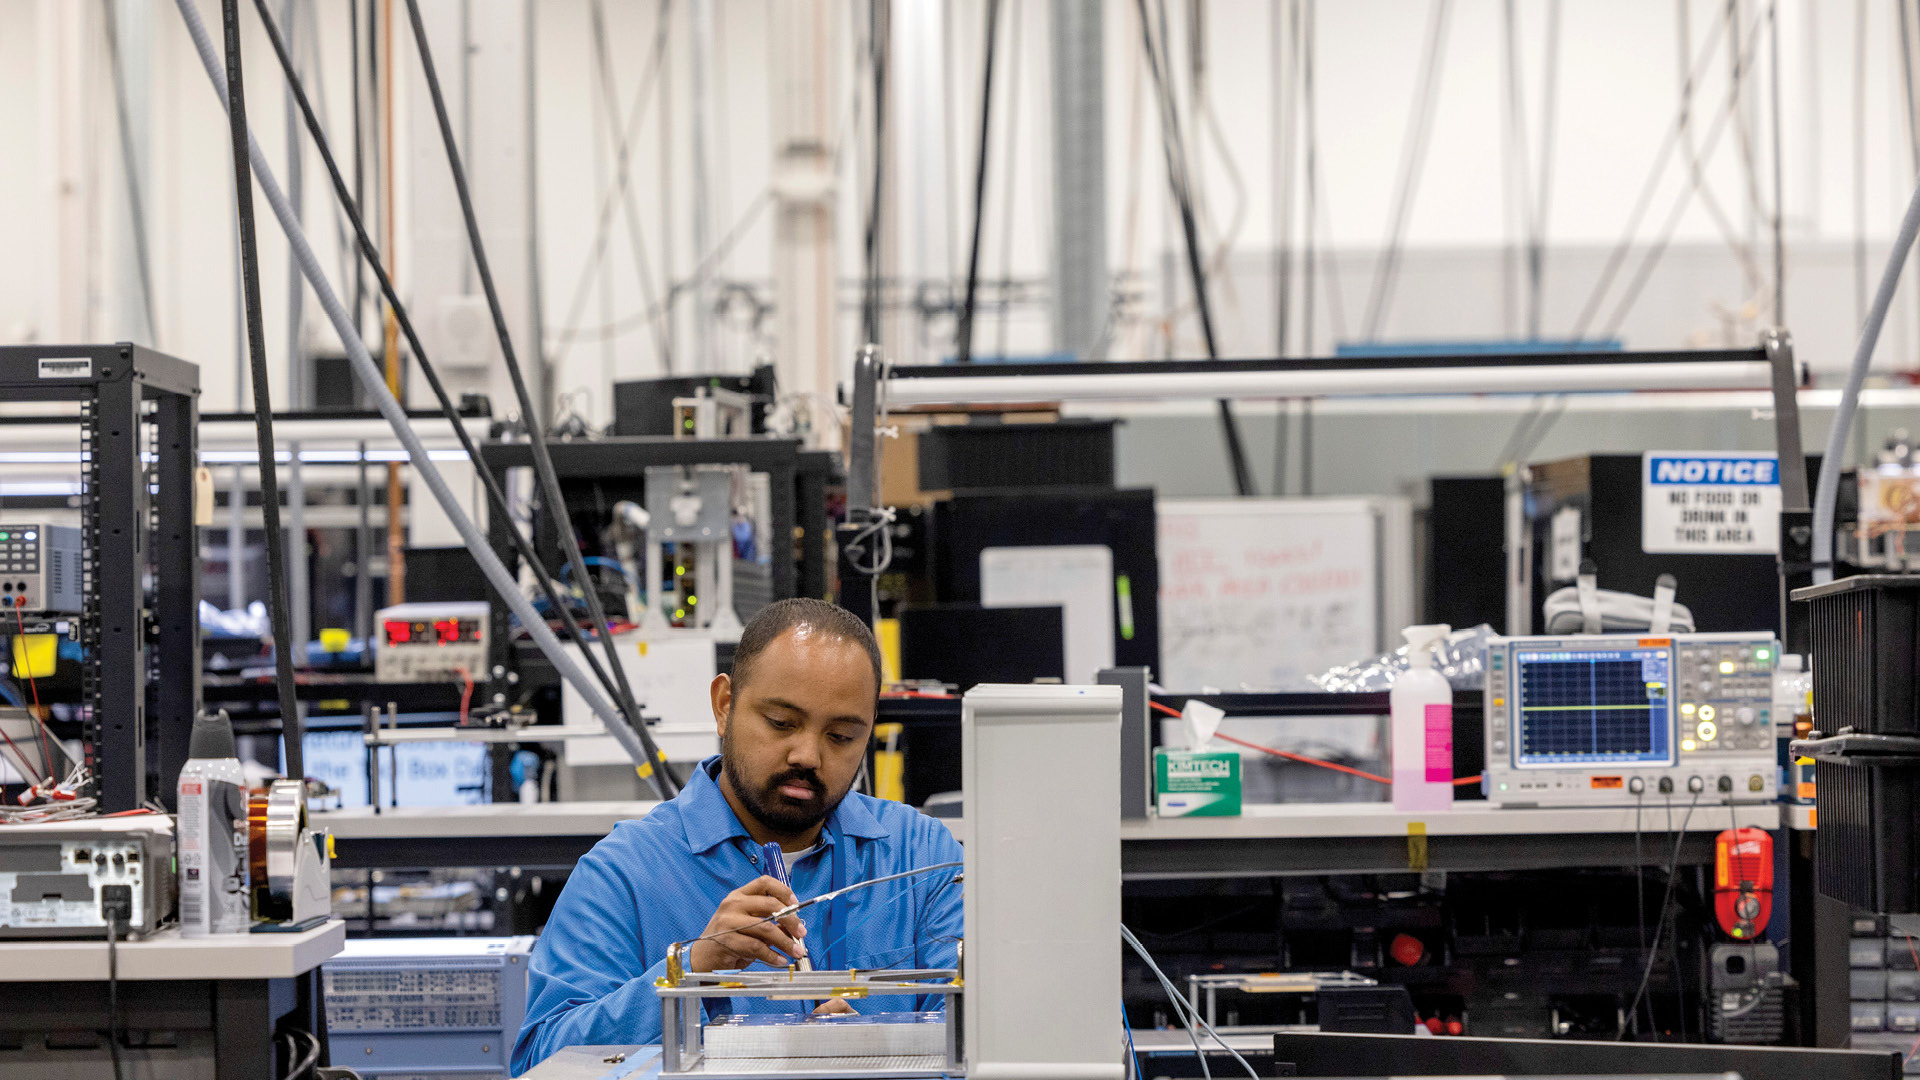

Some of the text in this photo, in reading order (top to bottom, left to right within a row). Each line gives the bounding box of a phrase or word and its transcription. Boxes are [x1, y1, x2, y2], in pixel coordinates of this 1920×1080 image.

[1657, 460, 1775, 482] NOTICE
[1670, 491, 1760, 504] NO FOOD OR
[1683, 509, 1748, 523] DRINK IN
[1675, 528, 1753, 541] THIS AREA
[1167, 760, 1230, 773] KIMTECH
